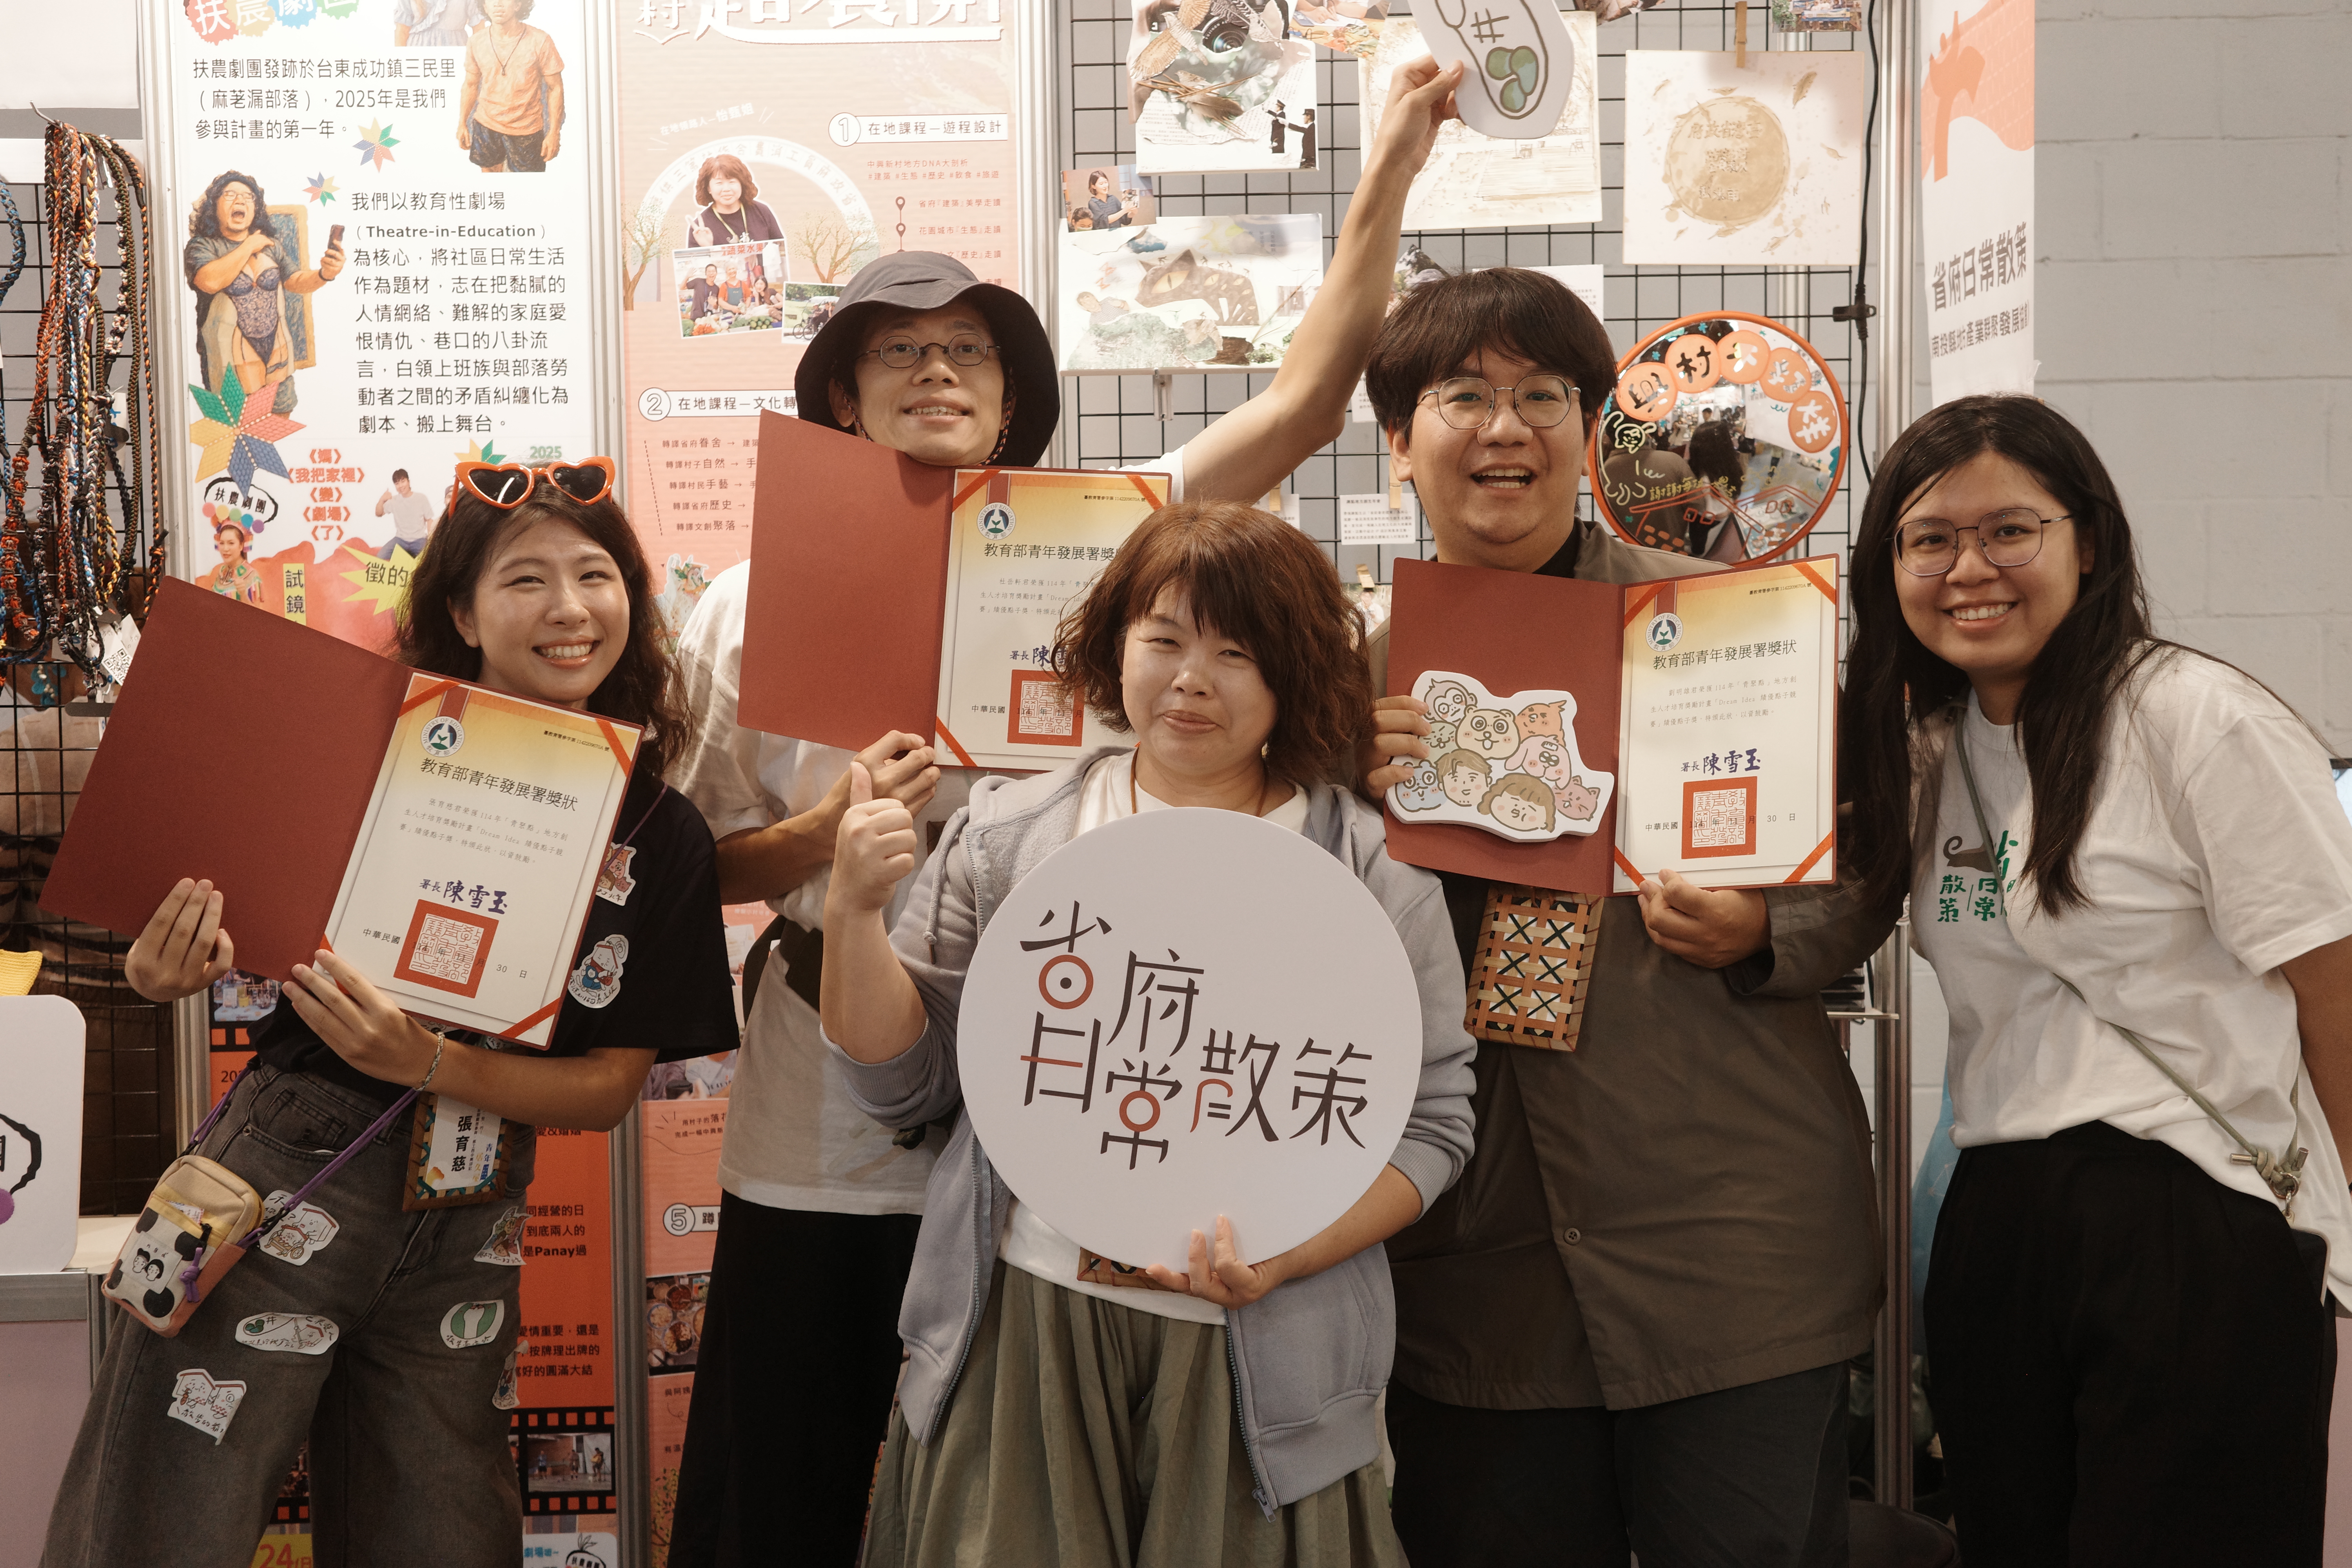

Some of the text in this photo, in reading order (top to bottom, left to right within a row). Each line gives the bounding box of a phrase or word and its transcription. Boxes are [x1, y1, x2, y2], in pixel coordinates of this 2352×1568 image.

[193, 58, 456, 79] 扶農劇團發跡於台東成功鎮三民里
[195, 119, 347, 140] 參與計畫的第一年。
[867, 159, 968, 169] 中興新村地方DNA大剖析
[351, 191, 505, 211] 我們以教育性劇場
[353, 247, 565, 267] 為核心，將社區日常生活
[940, 250, 1002, 259] 文『歷史』走讀
[1931, 221, 2027, 312] 省府日常散策
[354, 275, 566, 294] 作為題材，志在把黏膩的
[356, 303, 567, 322] 人情網絡、難解的家庭愛
[356, 330, 548, 350] 恨情仇、巷口的八卦流
[357, 358, 568, 378] 言，白領上班族與部落勞
[358, 386, 568, 407] 動者之間的矛盾糾纏化為
[359, 414, 506, 433] 劇本、搬上舞台。
[530, 445, 562, 459] 2025
[662, 437, 721, 448] 轉譯省府眷舍
[666, 458, 725, 469] 轉譯村子自然
[669, 479, 729, 490] 轉譯村民手藝
[214, 486, 267, 514] 扶農劇團
[673, 499, 732, 511] 轉譯省府歷史
[676, 520, 735, 532] 轉譯文創聚落
[978, 506, 990, 532] MINISTRY
[999, 504, 1015, 532] EDUCATION
[984, 543, 1118, 562] 教育部青年發展署獎
[285, 569, 305, 625] 試鏡
[1648, 617, 1658, 645] MINISTRY
[1666, 614, 1682, 641] EDUCATION
[1653, 639, 1797, 670] 教育部青年發展署獎狀
[971, 704, 1005, 714] 中華民國
[1074, 710, 1083, 718] 月
[423, 719, 439, 744] MINISTRY
[449, 719, 463, 751] EDUCATION
[420, 757, 579, 812] 教育部青年發展署獎狀
[1645, 821, 1679, 832] 中華民國
[1747, 815, 1756, 824] 月
[1767, 815, 1777, 823] 30
[1789, 813, 1796, 821] 日
[505, 835, 520, 844] Idea
[1937, 874, 1966, 922] 散策
[363, 927, 401, 945] 中華民國
[475, 958, 485, 967] 月
[496, 964, 508, 973] 30
[519, 970, 528, 979] 日
[221, 1070, 243, 1083] 20
[451, 1116, 473, 1172] 張育慈
[702, 1211, 721, 1225] 蹲
[526, 1224, 585, 1237] 到底兩人的
[523, 1244, 587, 1258] 是Panay過
[521, 1344, 600, 1357] 按牌理出牌的
